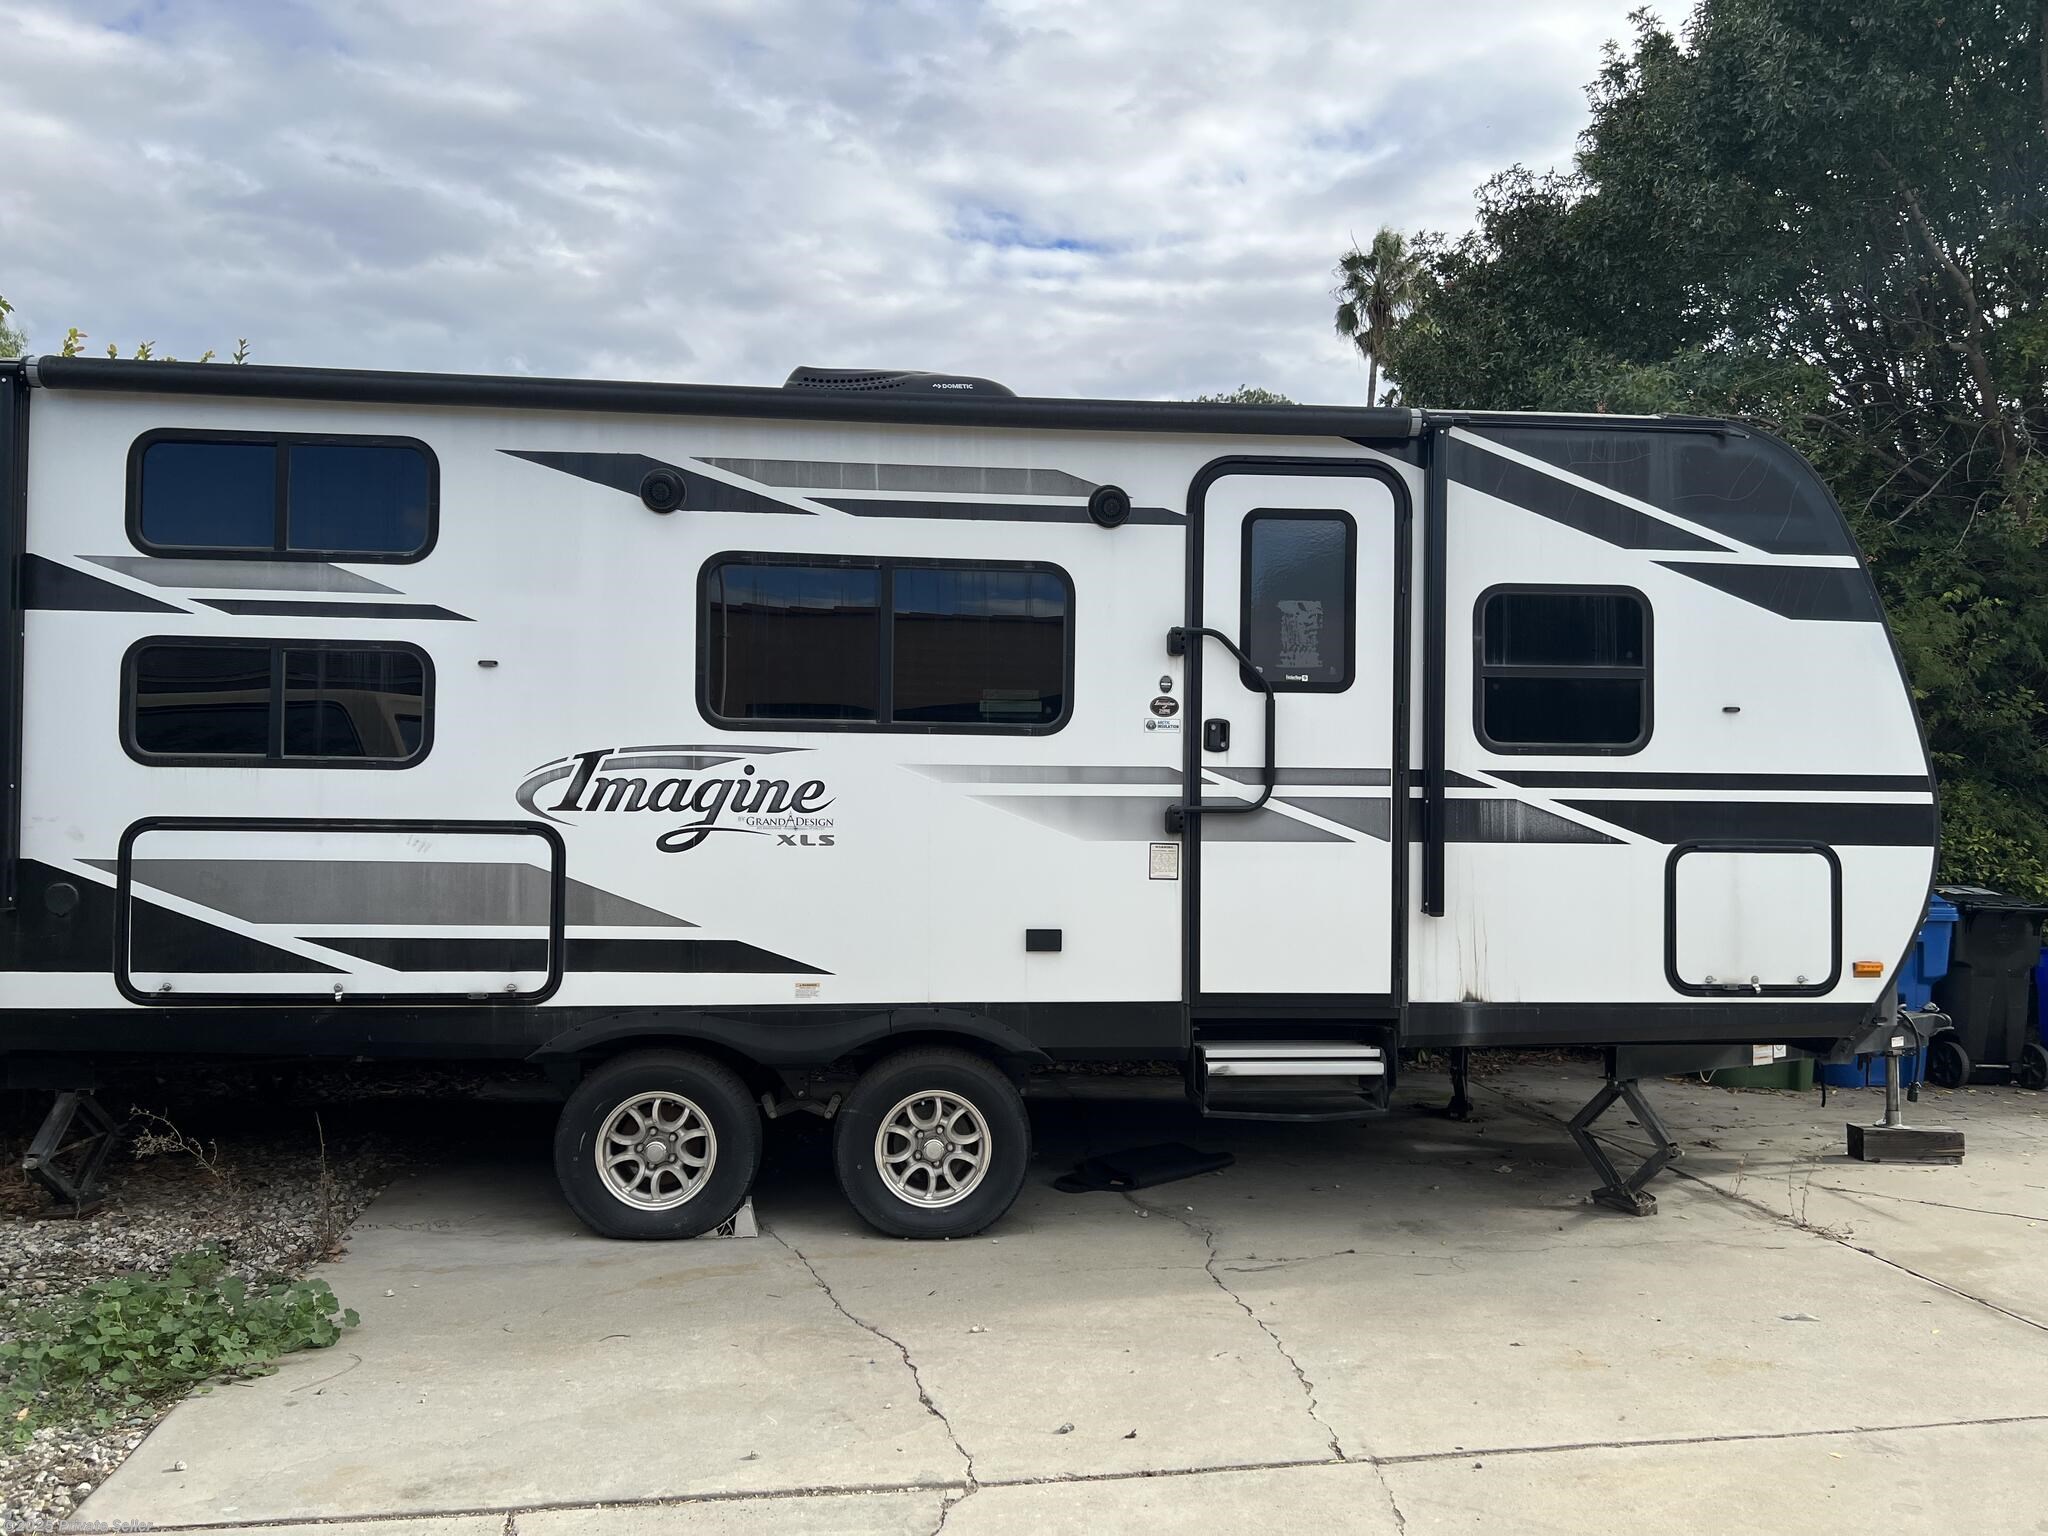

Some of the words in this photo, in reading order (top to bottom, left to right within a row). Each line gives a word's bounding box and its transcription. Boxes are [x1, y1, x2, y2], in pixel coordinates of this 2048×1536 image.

[547, 748, 837, 853] Imagine
[746, 816, 786, 826] GRAND
[796, 816, 834, 827] DESIGN
[776, 834, 835, 846] XLS
